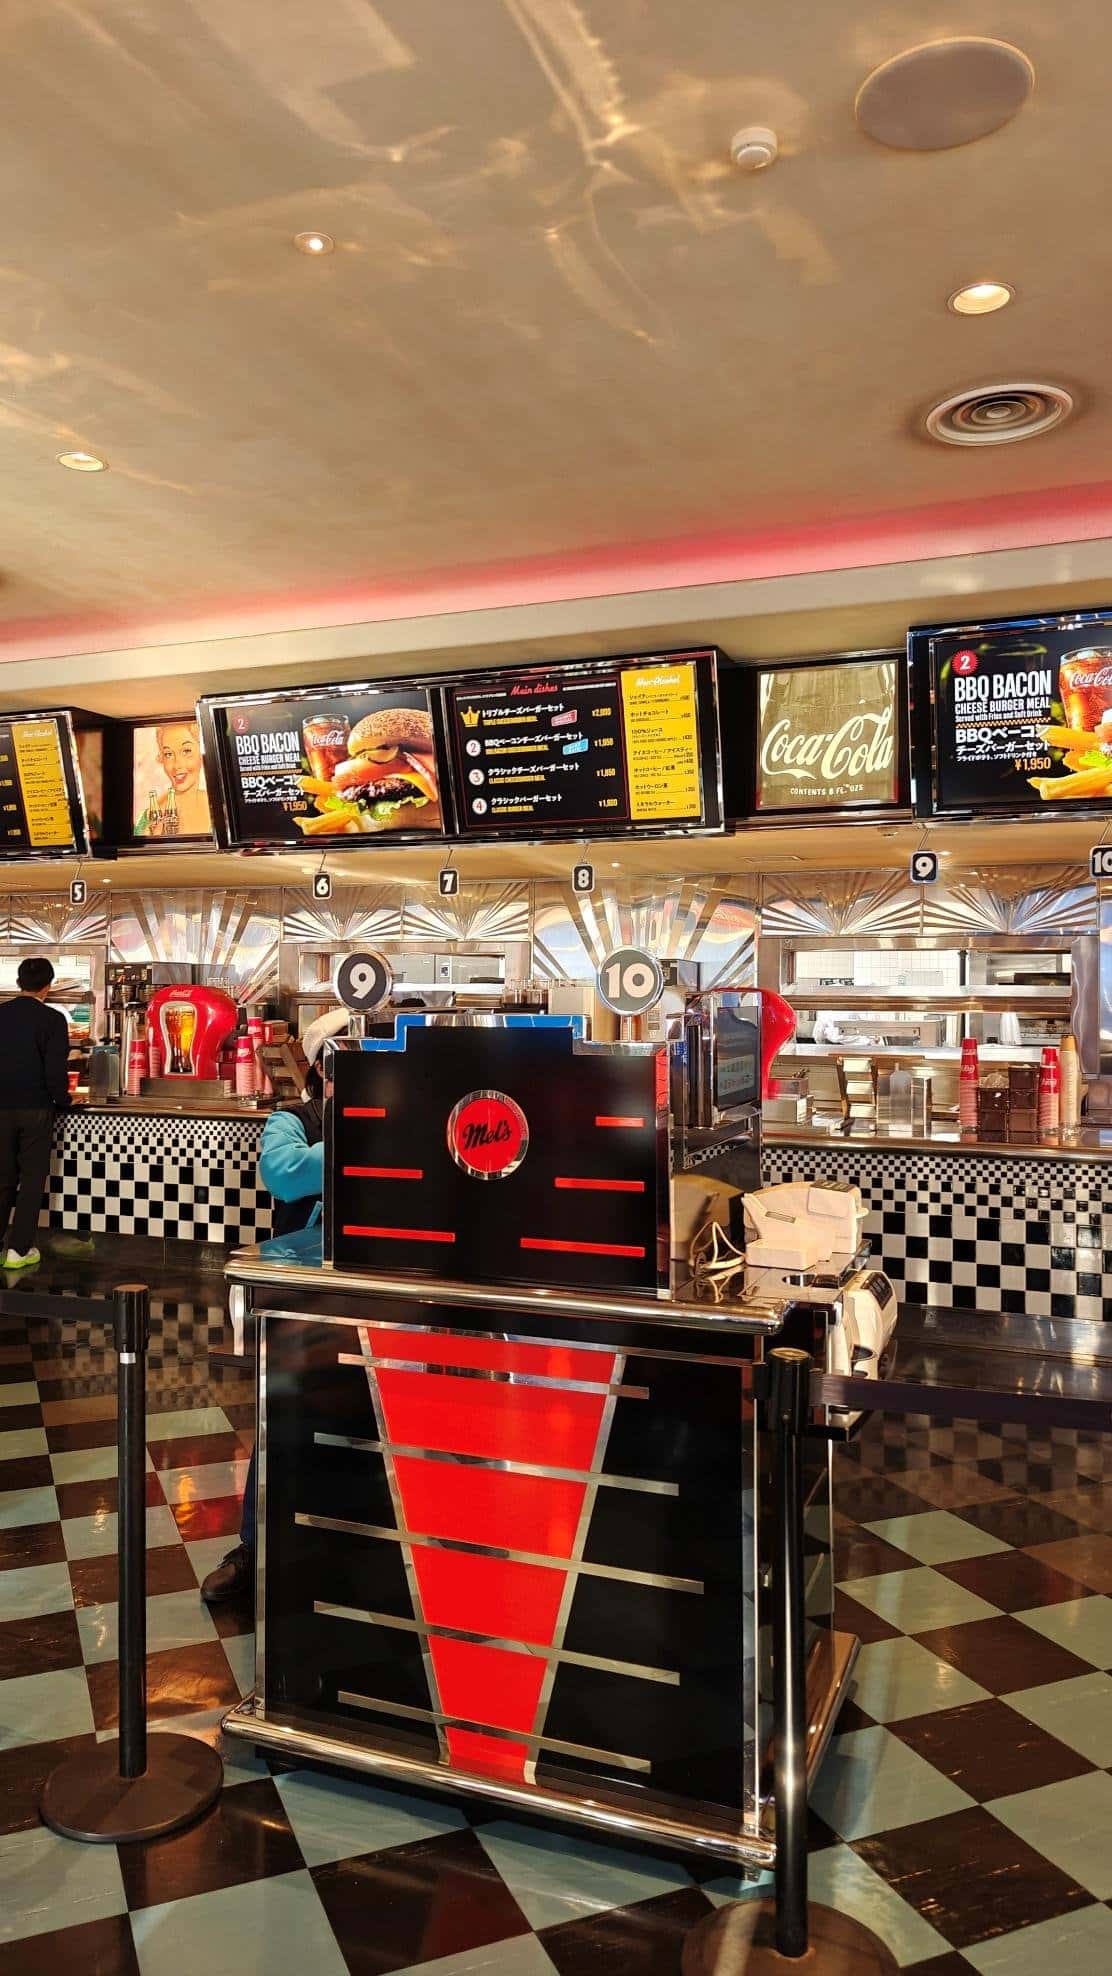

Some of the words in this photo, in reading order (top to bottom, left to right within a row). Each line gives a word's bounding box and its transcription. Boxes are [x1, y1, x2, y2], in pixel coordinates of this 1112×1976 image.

[959, 655, 971, 670] 2
[510, 684, 533, 696] Main
[533, 682, 558, 695] dishes
[954, 675, 990, 702] BBQ
[992, 669, 1052, 700] BACON
[954, 700, 989, 715] CHEESE
[989, 697, 1025, 713] BURGER
[1026, 696, 1052, 710] MEAL
[237, 718, 246, 730] 2
[235, 734, 261, 755] BBQ
[260, 731, 300, 753] BACON
[470, 742, 477, 753] 2
[761, 703, 894, 780] Coca-Cola
[956, 740, 1050, 756] チーズバーガーセット
[1014, 757, 1052, 771] ¥1,950
[472, 772, 481, 781] 3
[476, 801, 483, 811] 4
[915, 856, 934, 878] 9
[1092, 850, 1112, 873] 10
[316, 877, 329, 896] 6
[443, 873, 455, 893] 7
[577, 869, 590, 888] 8
[73, 884, 83, 902] 5
[349, 962, 376, 1000] 9
[605, 962, 655, 999] 10
[462, 1119, 512, 1151] Mel's
